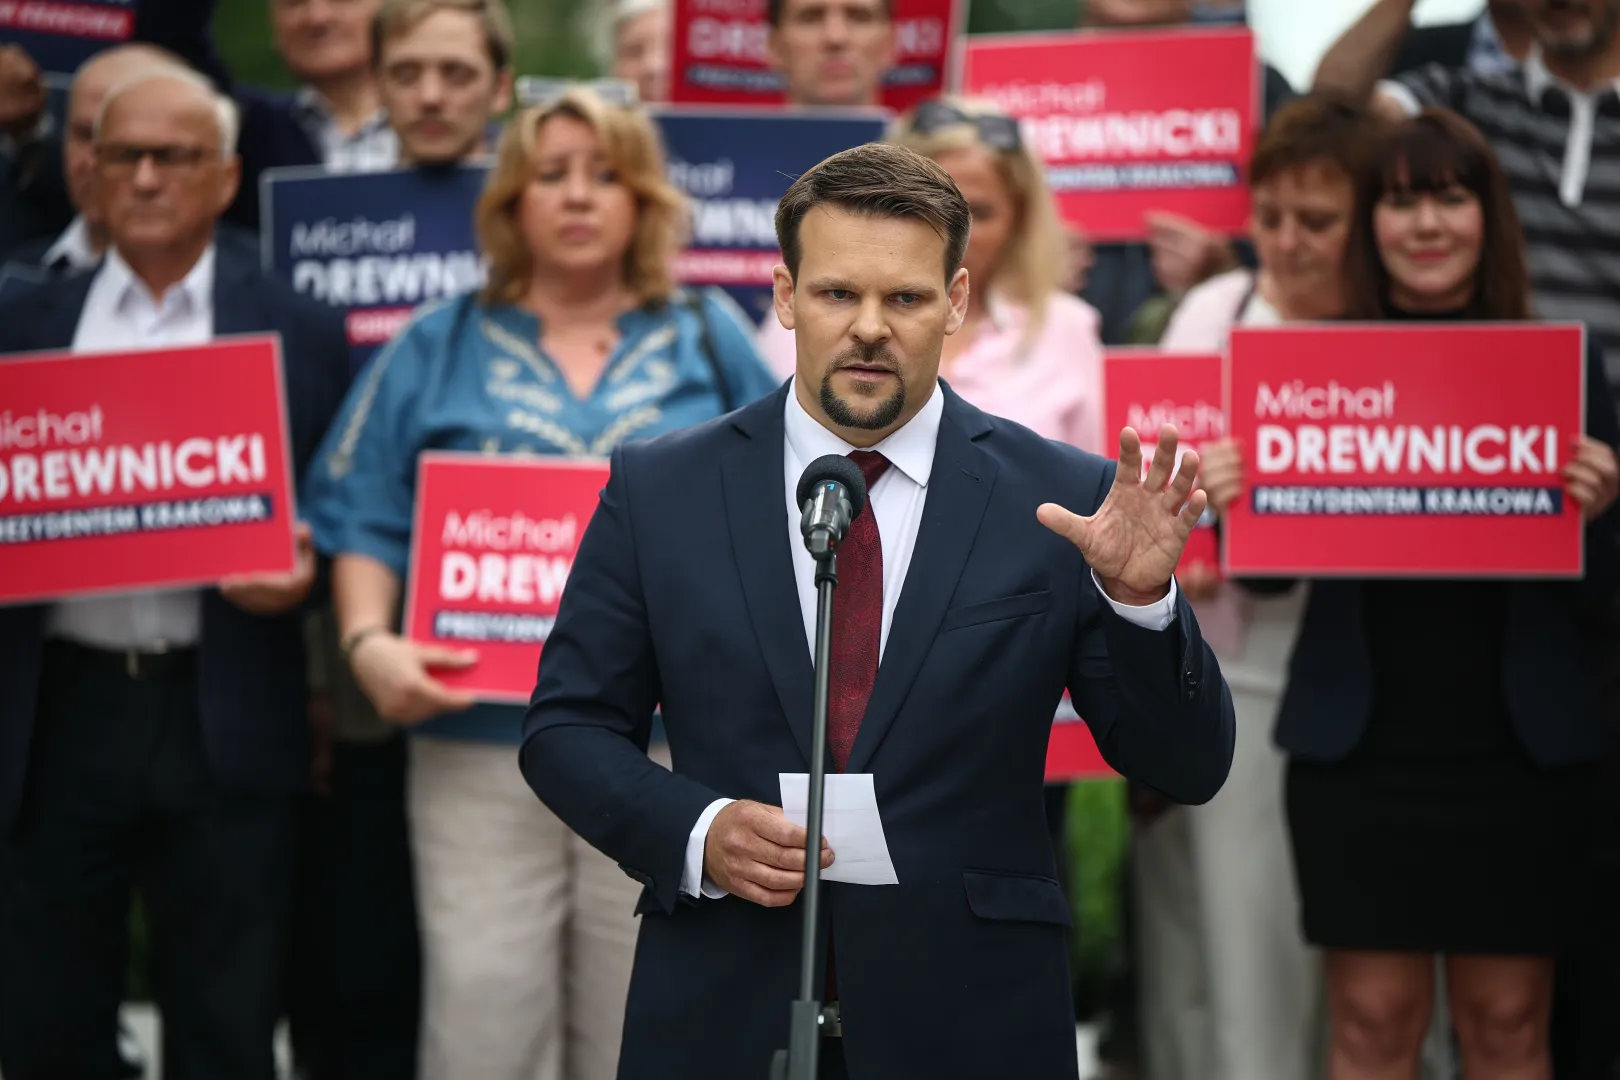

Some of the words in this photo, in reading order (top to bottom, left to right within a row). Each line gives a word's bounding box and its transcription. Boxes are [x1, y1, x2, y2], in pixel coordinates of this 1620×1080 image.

[1019, 110, 1240, 158] REWNICKI
[1254, 380, 1396, 419] Michał
[0, 403, 104, 450] ichał
[1256, 424, 1558, 474] DREWNICKI
[0, 432, 267, 503] REWNICKI
[1254, 486, 1422, 515] PREZYDENTEM
[1425, 486, 1553, 515] KRAKOWA
[441, 508, 578, 553] Michał
